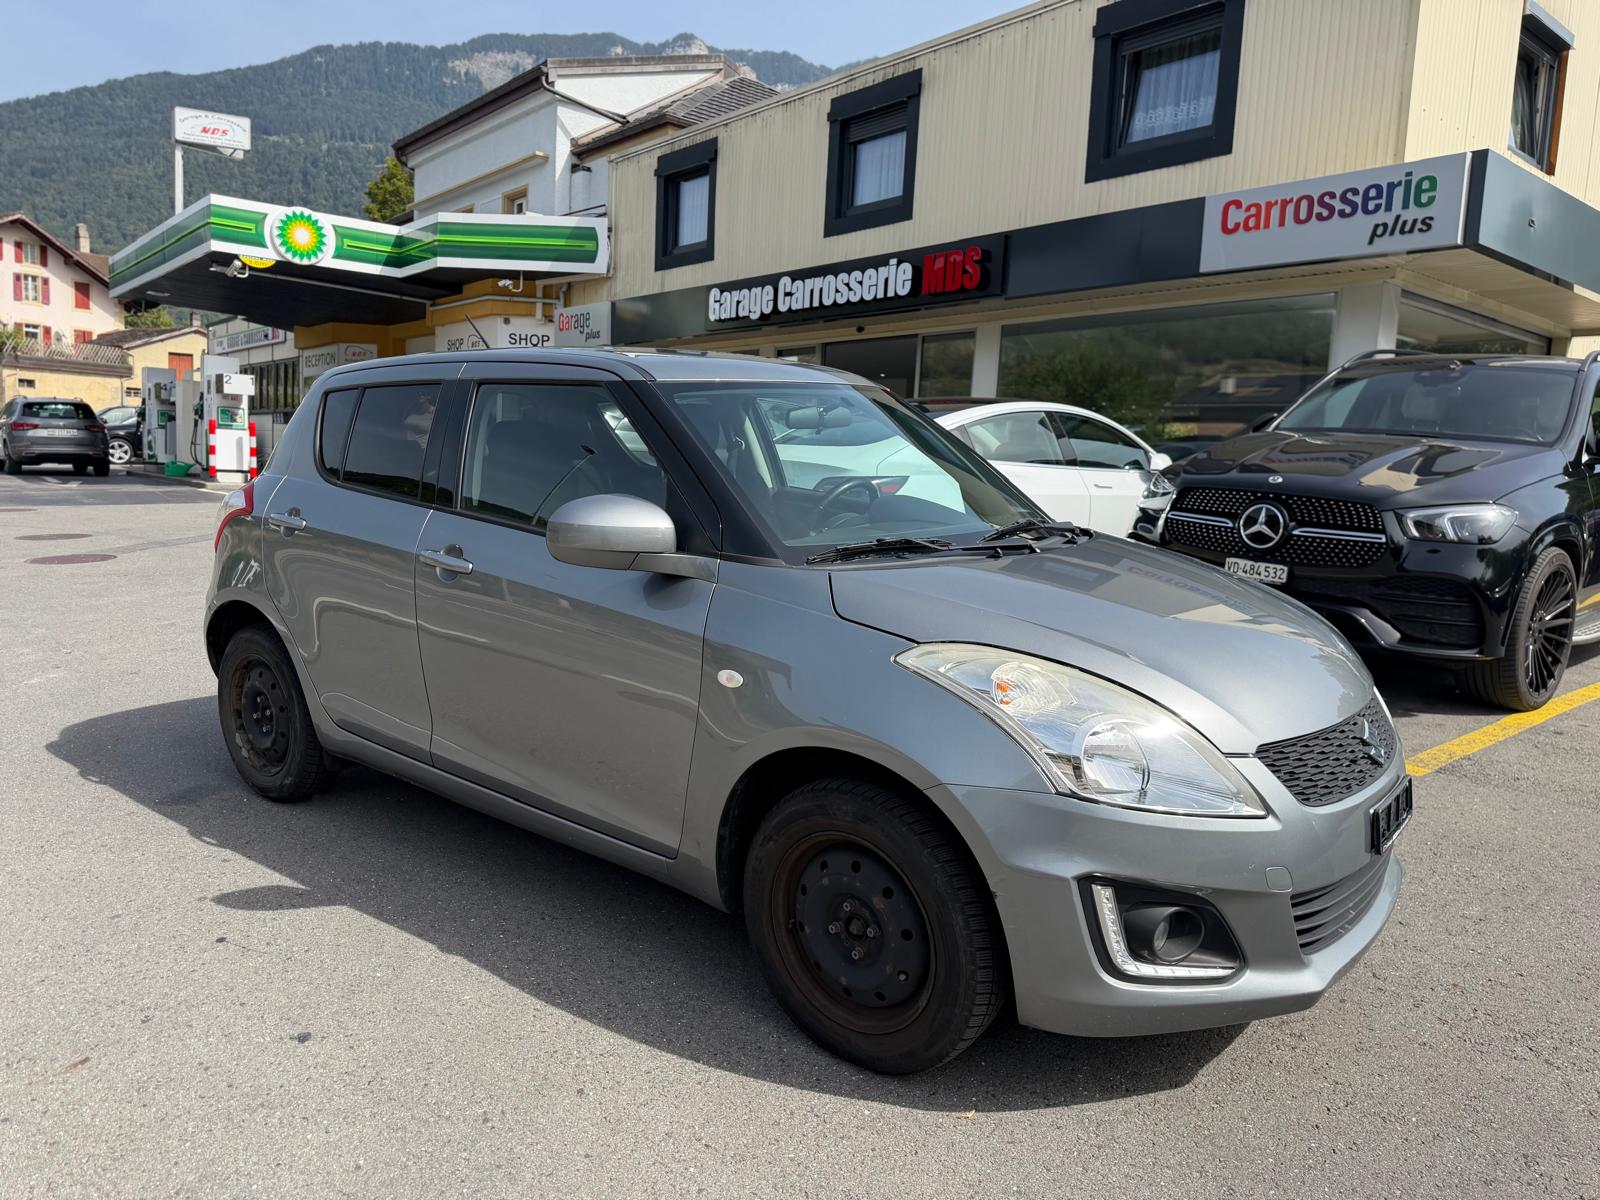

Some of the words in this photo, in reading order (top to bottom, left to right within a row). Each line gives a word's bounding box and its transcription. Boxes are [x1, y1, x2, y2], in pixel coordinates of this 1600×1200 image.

[1221, 171, 1438, 236] Carrosserie
[1367, 214, 1434, 246] plus
[708, 287, 774, 321] Garage
[777, 257, 913, 312] Carrosserie
[921, 246, 981, 295] MDS
[558, 312, 591, 334] Garage
[508, 333, 550, 347] SHOP
[585, 329, 601, 342] plus
[447, 338, 464, 350] SHOP
[305, 351, 336, 368] RECEPTION
[224, 374, 232, 385] 2
[1264, 565, 1285, 580] 532
